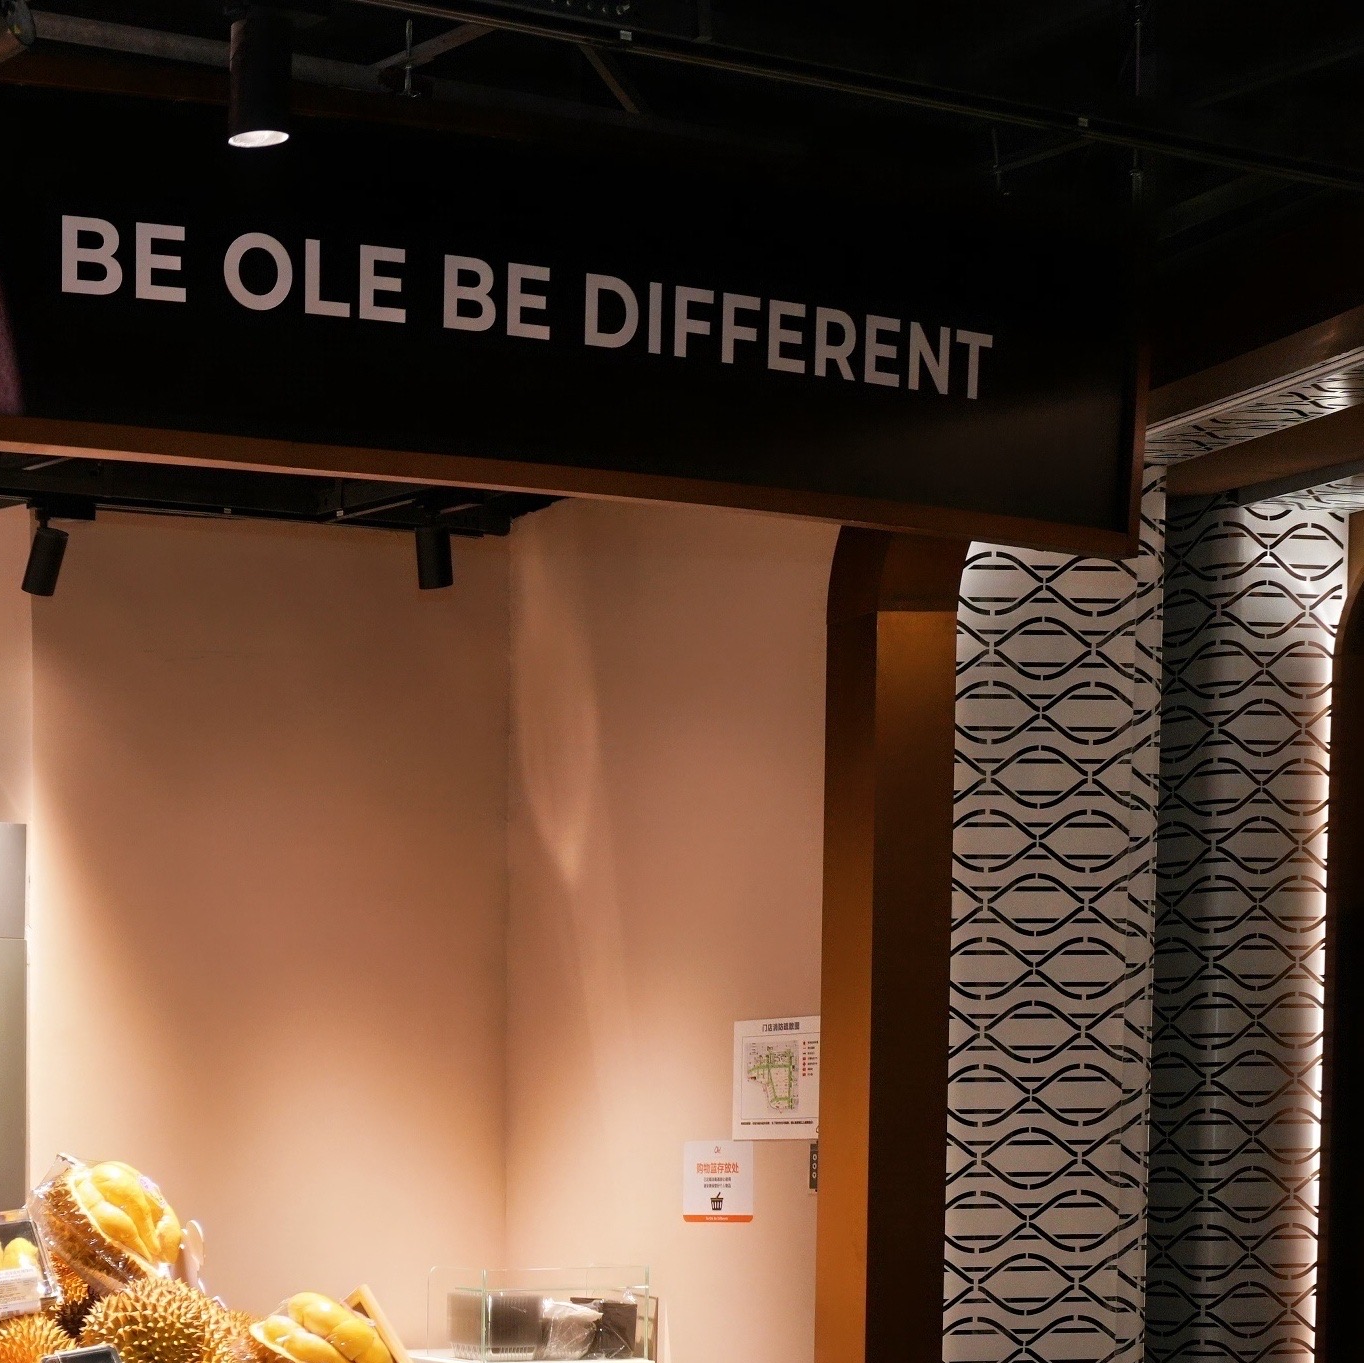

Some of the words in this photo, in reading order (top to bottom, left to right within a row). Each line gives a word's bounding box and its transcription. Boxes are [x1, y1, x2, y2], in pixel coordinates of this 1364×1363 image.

[60, 214, 188, 304] BE
[222, 231, 407, 324] OLE
[442, 253, 551, 341] BE
[583, 271, 993, 399] DIFFERENT
[696, 1162, 740, 1175] 购物篮存放处
